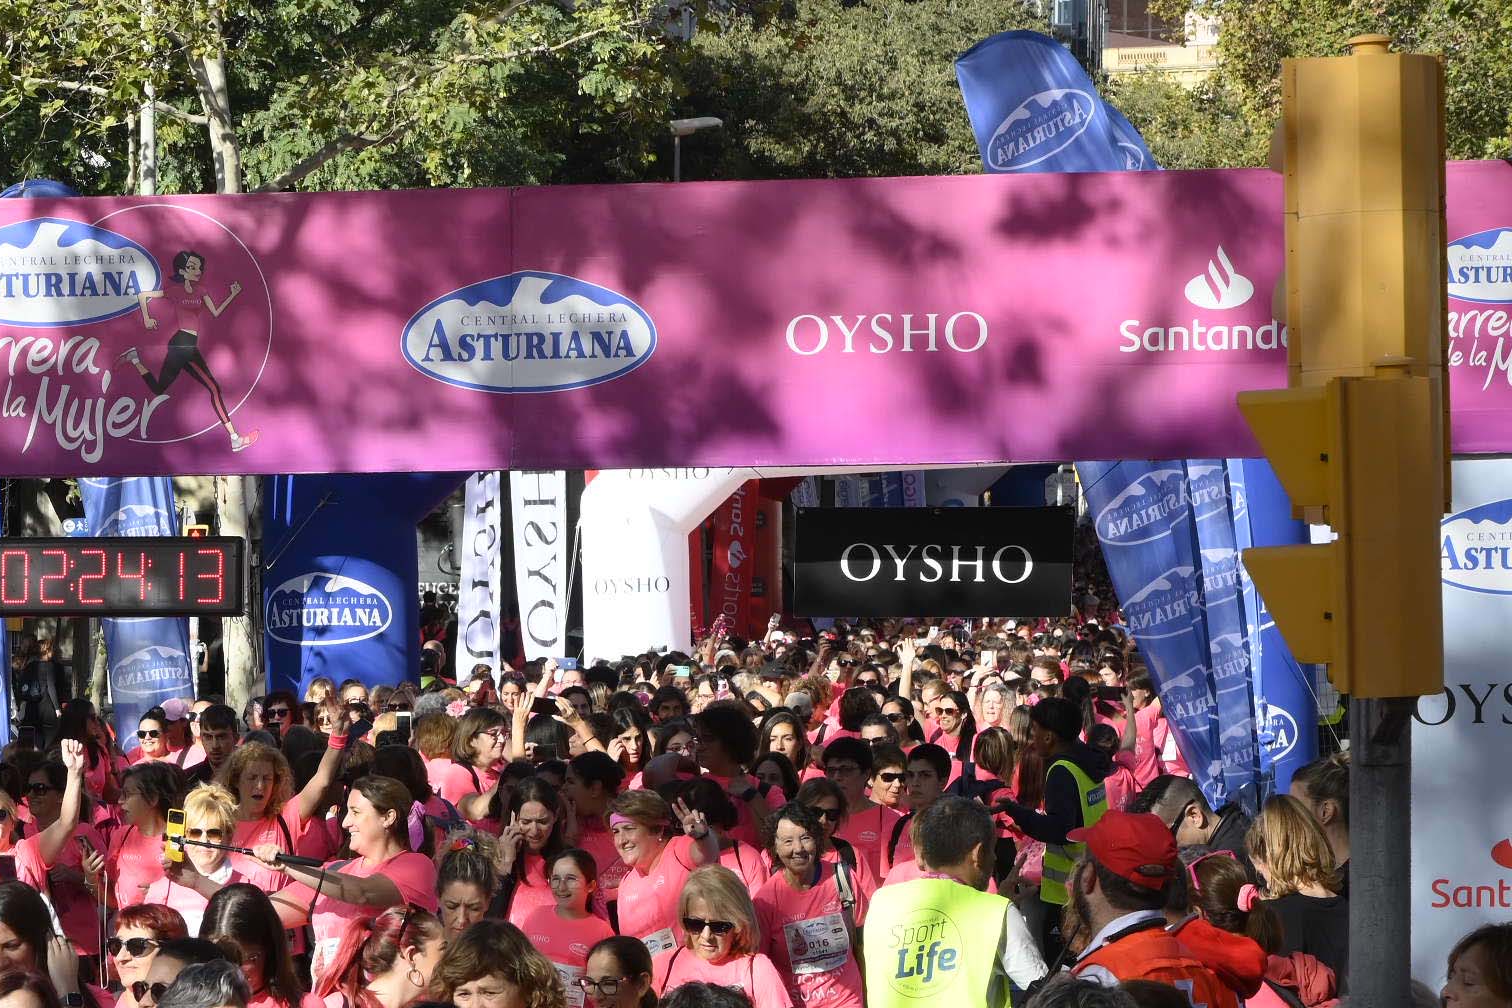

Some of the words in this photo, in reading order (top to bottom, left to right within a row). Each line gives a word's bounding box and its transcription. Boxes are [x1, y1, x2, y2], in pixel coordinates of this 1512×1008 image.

[64, 254, 136, 265] LECHERA
[461, 314, 538, 326] CENTRAL
[547, 312, 628, 323] LECHERA
[785, 311, 988, 355] OYSHO
[421, 318, 637, 362] ASTURIANA
[1469, 338, 1487, 366] la
[2, 378, 27, 418] la
[22, 370, 170, 464] Mujer
[1, 549, 225, 604] 02:24:13
[840, 542, 1034, 584] OYSHO
[594, 576, 670, 594] OYSHO
[282, 598, 322, 606] CENTRAL
[328, 597, 378, 605] LECHERA
[270, 604, 382, 629] ASTURIANA
[809, 939, 829, 949] 016
[888, 919, 947, 949] Sport
[895, 941, 957, 984] Life
